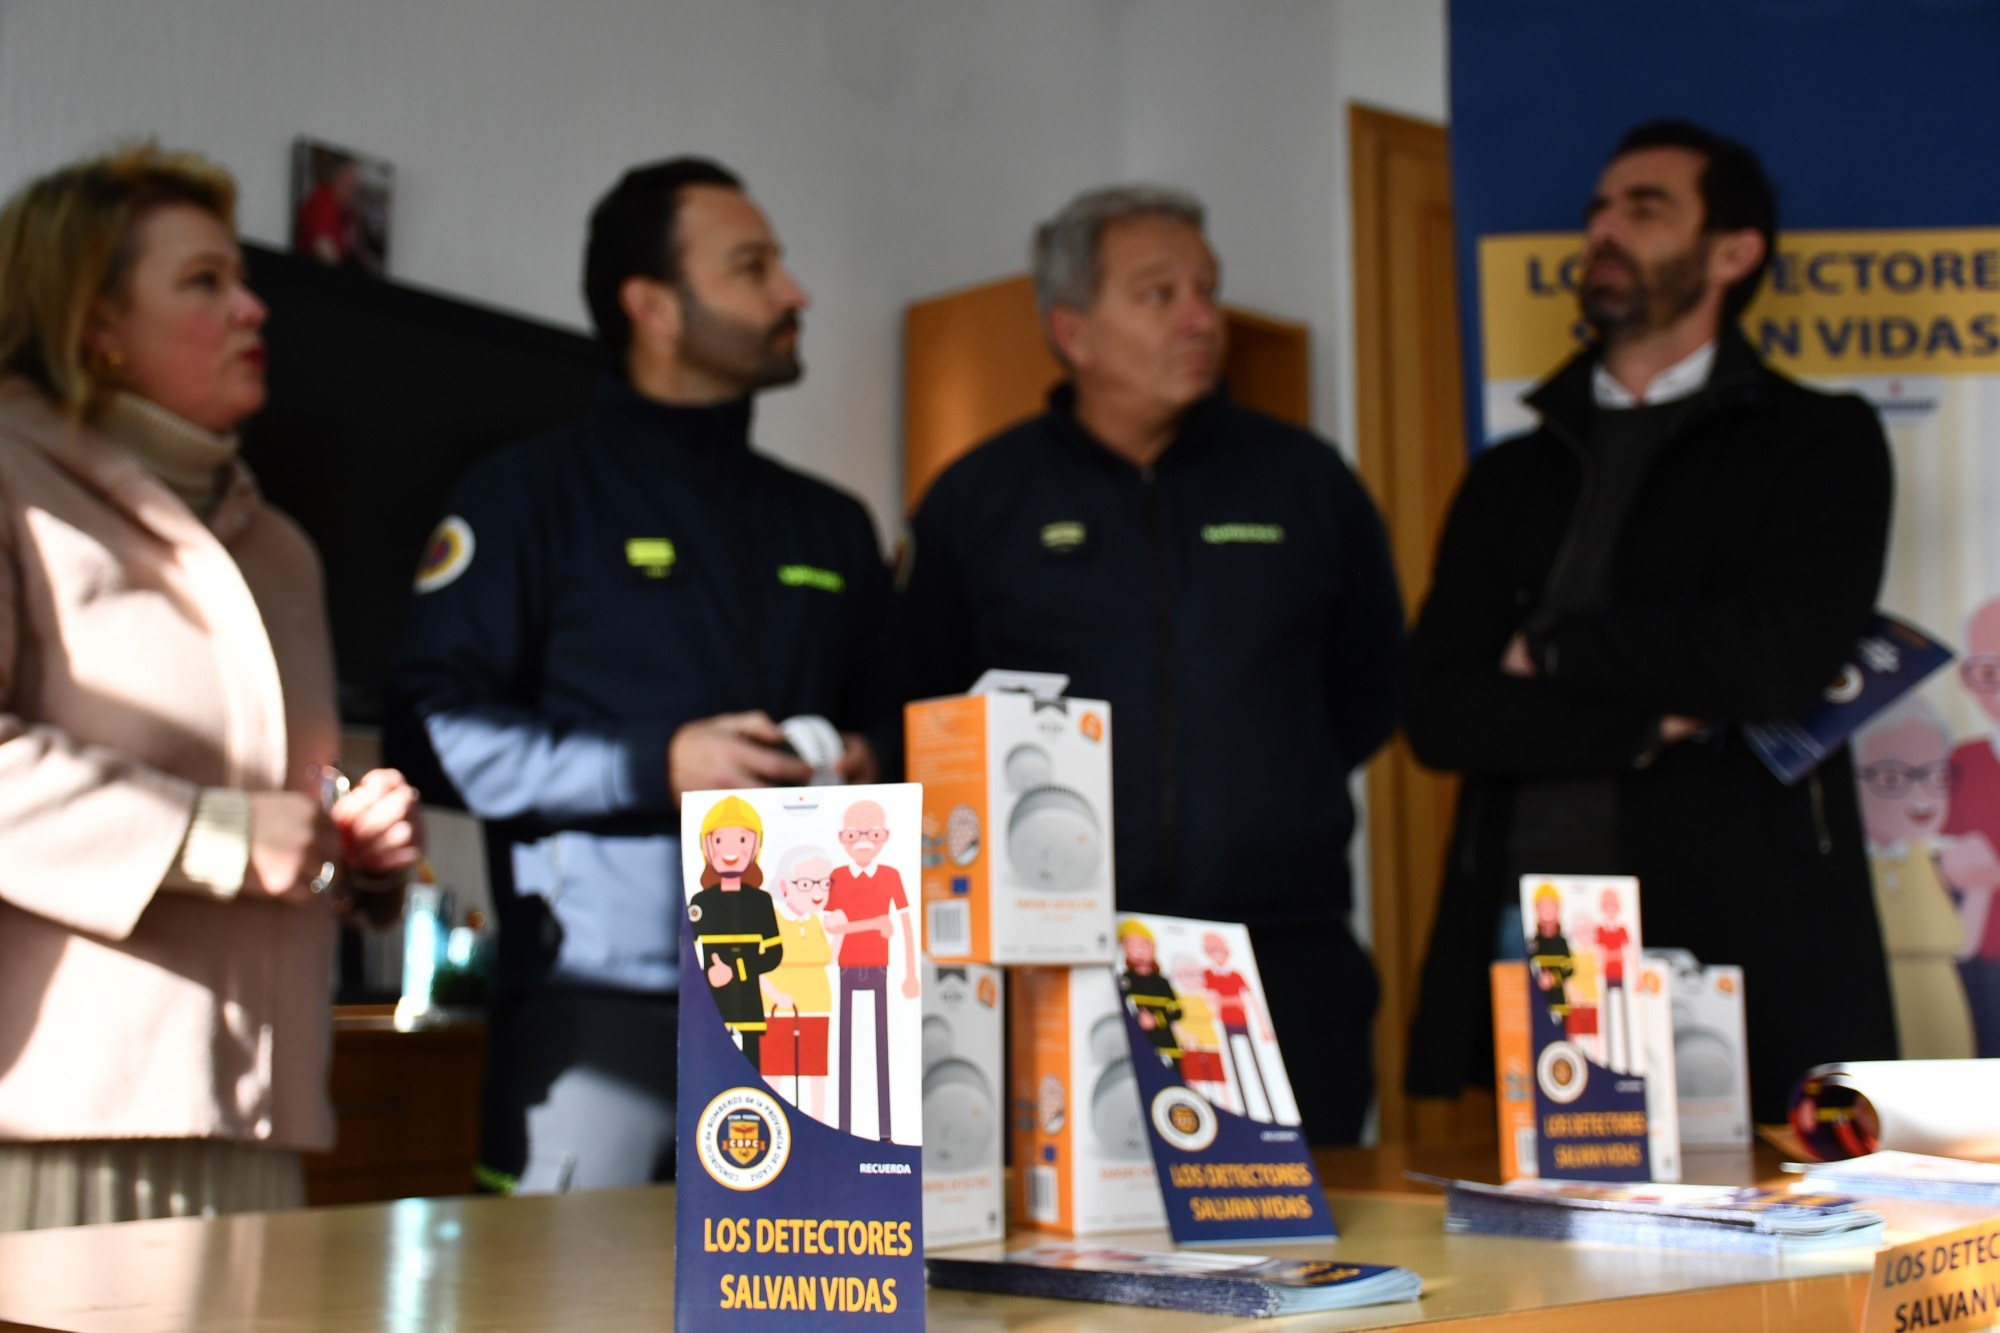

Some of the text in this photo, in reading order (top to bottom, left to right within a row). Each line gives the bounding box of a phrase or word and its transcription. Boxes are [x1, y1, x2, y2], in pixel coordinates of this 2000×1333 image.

[1527, 250, 2000, 297] LO ECTORE
[1815, 314, 2000, 359] VIDAS
[859, 1162, 912, 1175] RECUERDA
[704, 1217, 913, 1257] LOS DETECTORES
[1884, 1232, 2000, 1288] LOS DETEC
[720, 1273, 898, 1314] SALVAN VIDAS
[1894, 1287, 1987, 1333] SALVAN
